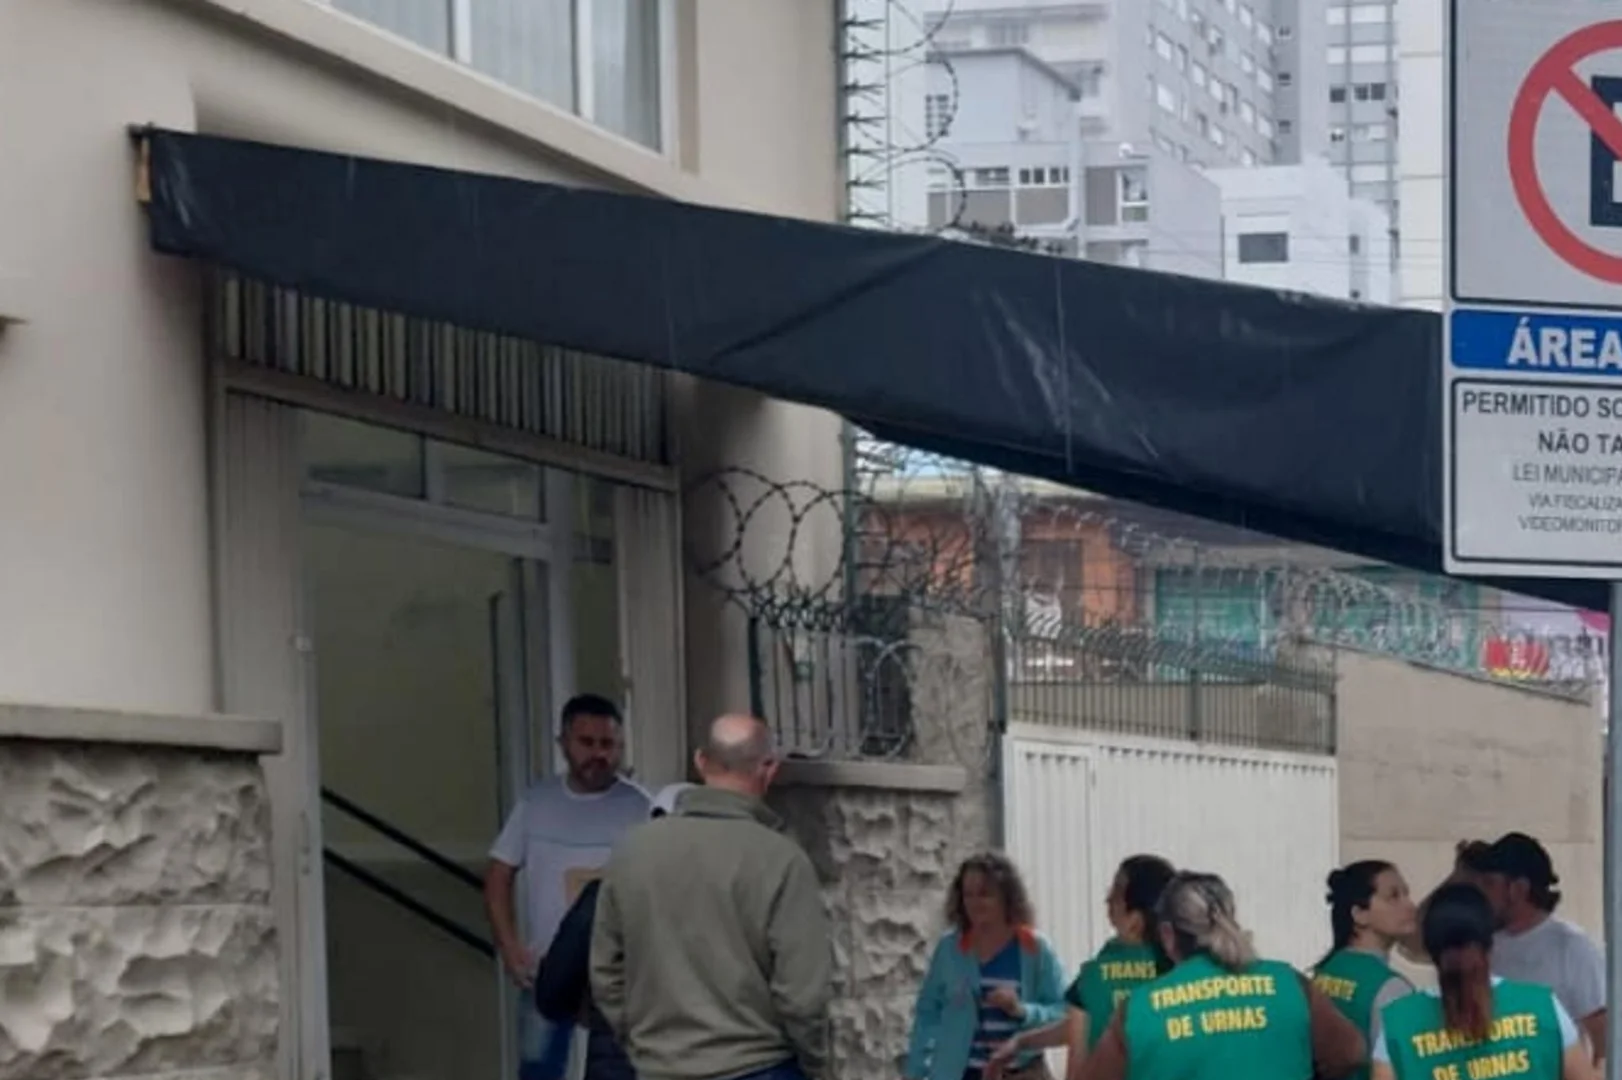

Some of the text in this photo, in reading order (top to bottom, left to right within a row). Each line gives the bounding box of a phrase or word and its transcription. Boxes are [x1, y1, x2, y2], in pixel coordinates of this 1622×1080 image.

[1462, 391, 1590, 418] PERMITIDO
[1538, 427, 1589, 454] NÃO
[1513, 463, 1540, 482] LEI
[1150, 975, 1276, 1011] TRANSPORTE
[1167, 1007, 1267, 1040] DE URNAS
[1467, 1049, 1531, 1080] URNAS
